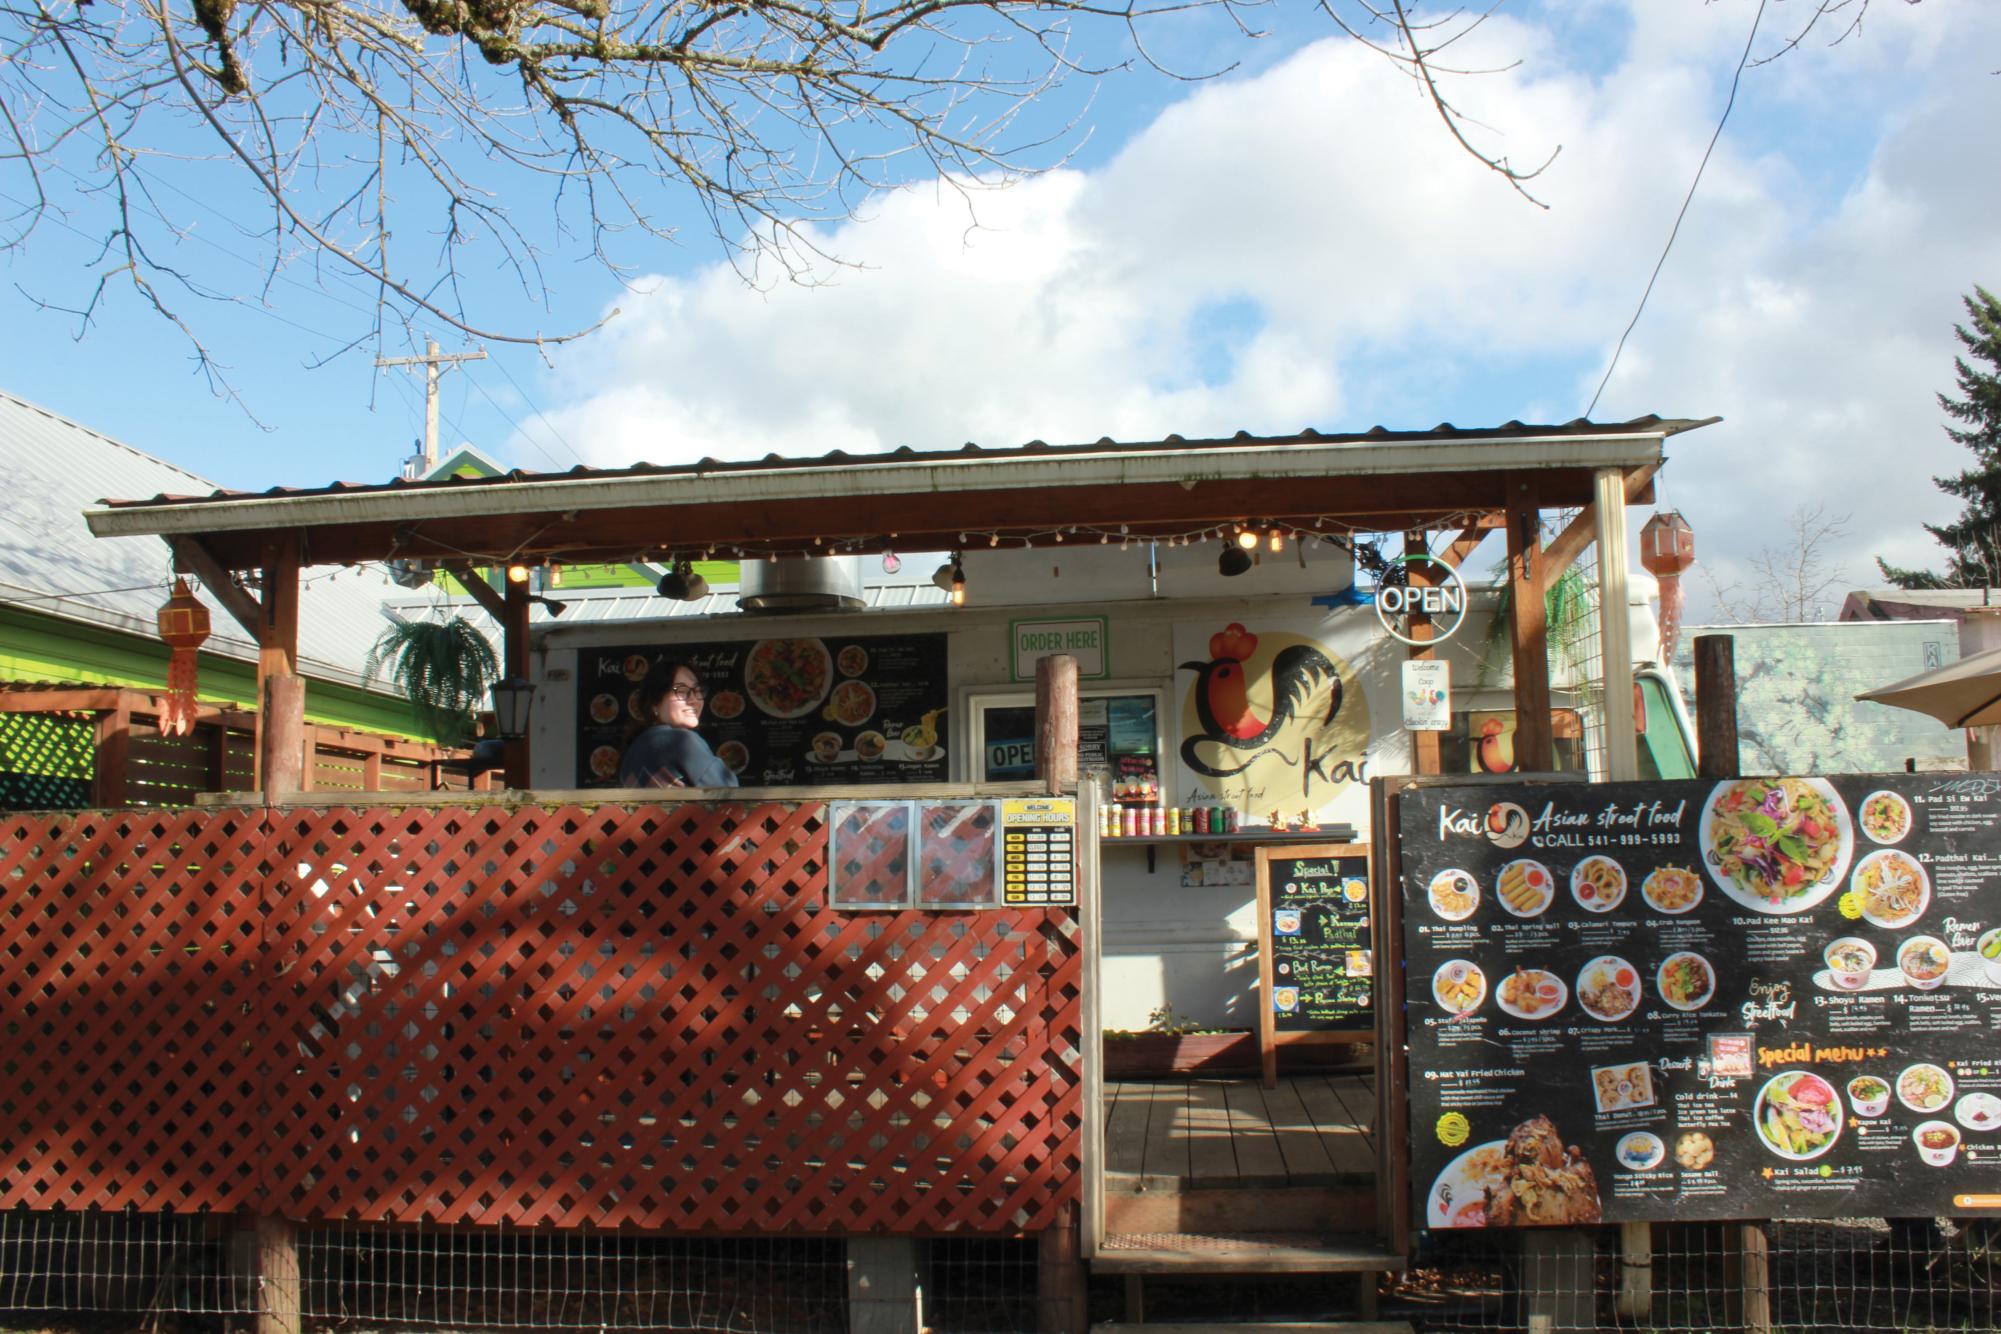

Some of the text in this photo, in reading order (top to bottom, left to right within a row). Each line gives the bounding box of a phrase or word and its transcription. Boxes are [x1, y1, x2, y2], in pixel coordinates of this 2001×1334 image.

[1381, 587, 1460, 612] OPEN
[1021, 630, 1097, 651] ORDER HERE
[1926, 643, 1938, 667] KA
[598, 657, 621, 678] Kai
[992, 743, 1036, 767] OPE
[1303, 737, 1371, 798] Kai
[1914, 795, 1926, 803] 11.
[1928, 794, 1943, 802] Pad
[1946, 794, 1956, 802] Si
[1973, 794, 1988, 802] Kai
[1007, 812, 1070, 823] OPENING HOURS
[1439, 799, 1686, 841] Kai Asian street food
[1546, 833, 1585, 847] CALL
[1918, 853, 1987, 862] 12. Padthai Kai
[1646, 919, 1659, 928] 04.
[1733, 917, 1746, 925] 10.
[1747, 917, 1761, 925] Pad
[1798, 915, 1814, 923] Kai
[1942, 916, 1981, 933] Ramen
[1749, 977, 1791, 1001] Enjoy
[1814, 996, 1828, 1007] 13.
[1828, 995, 1855, 1005] Shoyu
[1893, 994, 1908, 1004] 14.
[1976, 993, 1989, 1003] 15.
[1647, 1011, 1661, 1020] 08.
[1757, 1042, 1812, 1068] Special
[1424, 1071, 1438, 1080] 09.
[1471, 1069, 1494, 1077] Fried
[1494, 1069, 1525, 1077] Chicken
[1696, 1092, 1719, 1100] drink
[1774, 1167, 1789, 1175] Kai
[1793, 1167, 1818, 1175] Salad
